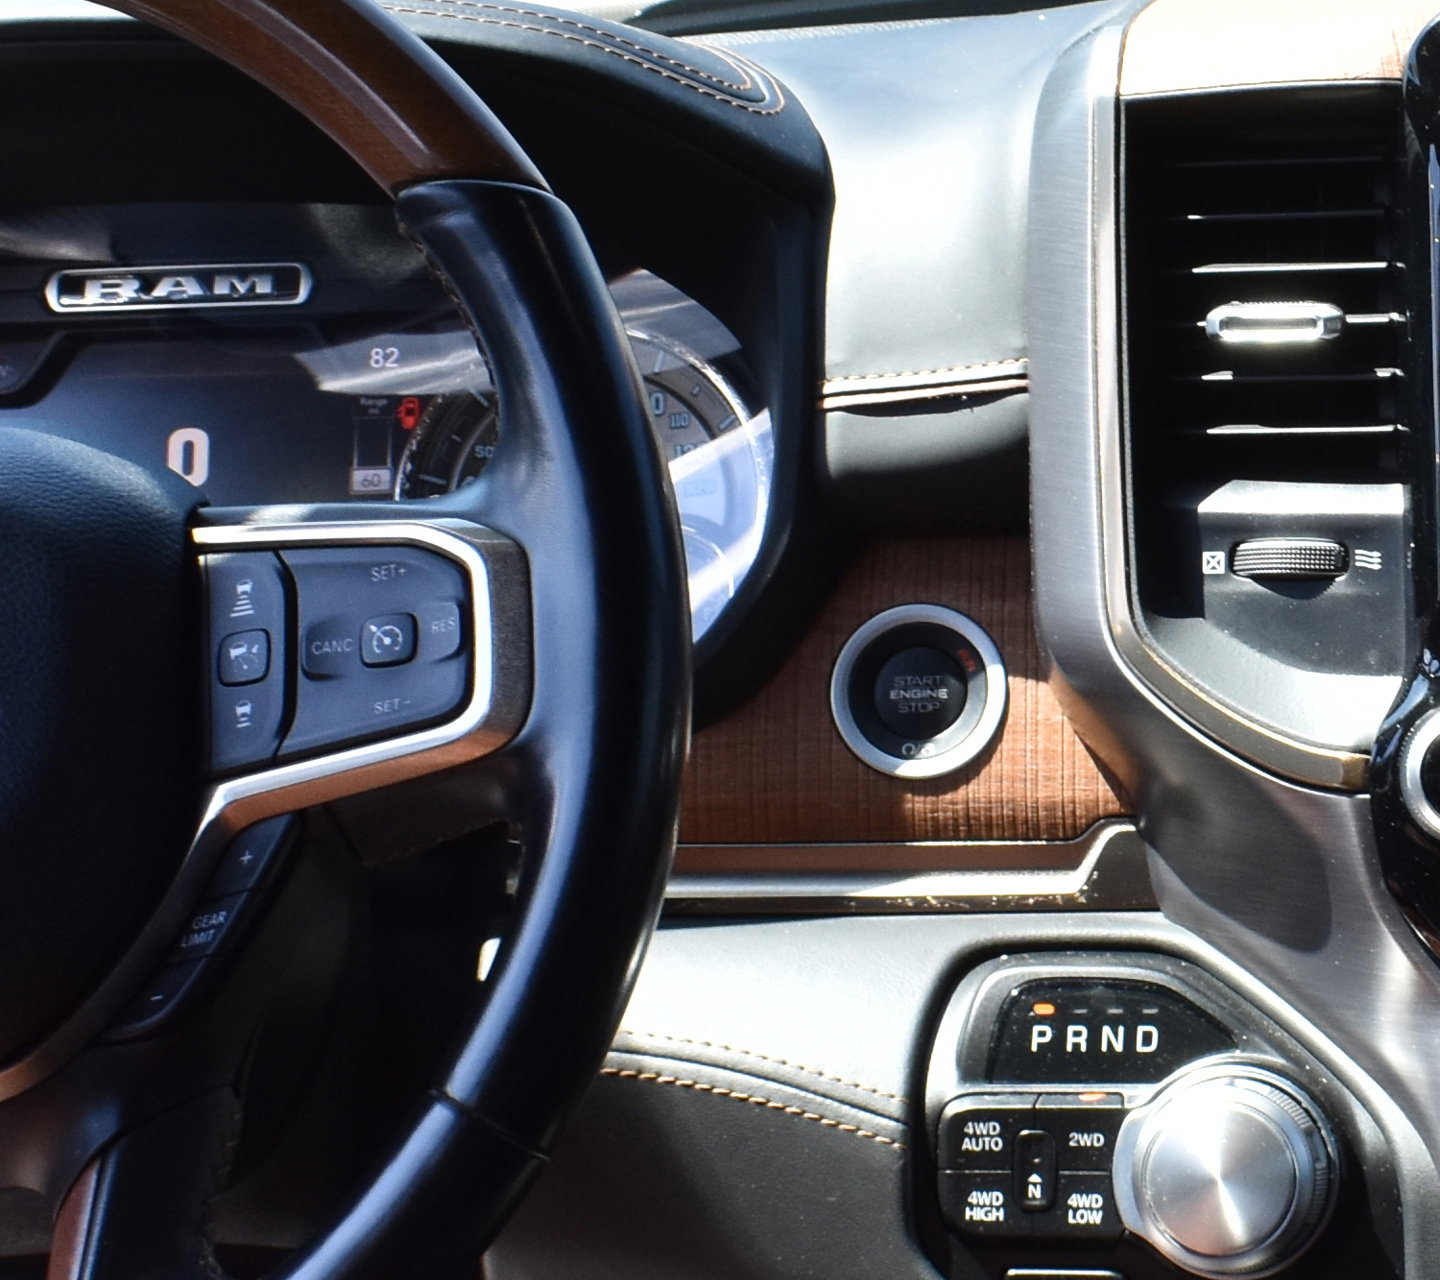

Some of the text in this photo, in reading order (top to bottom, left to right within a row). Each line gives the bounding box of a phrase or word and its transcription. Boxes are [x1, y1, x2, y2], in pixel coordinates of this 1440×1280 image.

[84, 272, 274, 299] RAM
[369, 348, 400, 368] 82
[166, 426, 210, 488] 0
[430, 617, 456, 634] RES
[311, 637, 354, 655] CANC
[893, 675, 942, 687] START
[889, 688, 948, 700] ENGINE
[898, 701, 940, 713] STOP
[193, 911, 227, 930] GEAR
[181, 928, 216, 948] LIMIT
[963, 1120, 1001, 1137] 4WD
[961, 1136, 1003, 1153] AUTO
[1068, 1132, 1105, 1148] 2WD
[967, 1190, 1004, 1206] 4WD
[1027, 1184, 1042, 1199] N
[1067, 1193, 1103, 1209] 4WD
[965, 1206, 1005, 1223] HIGH
[1067, 1208, 1103, 1225] LOW
